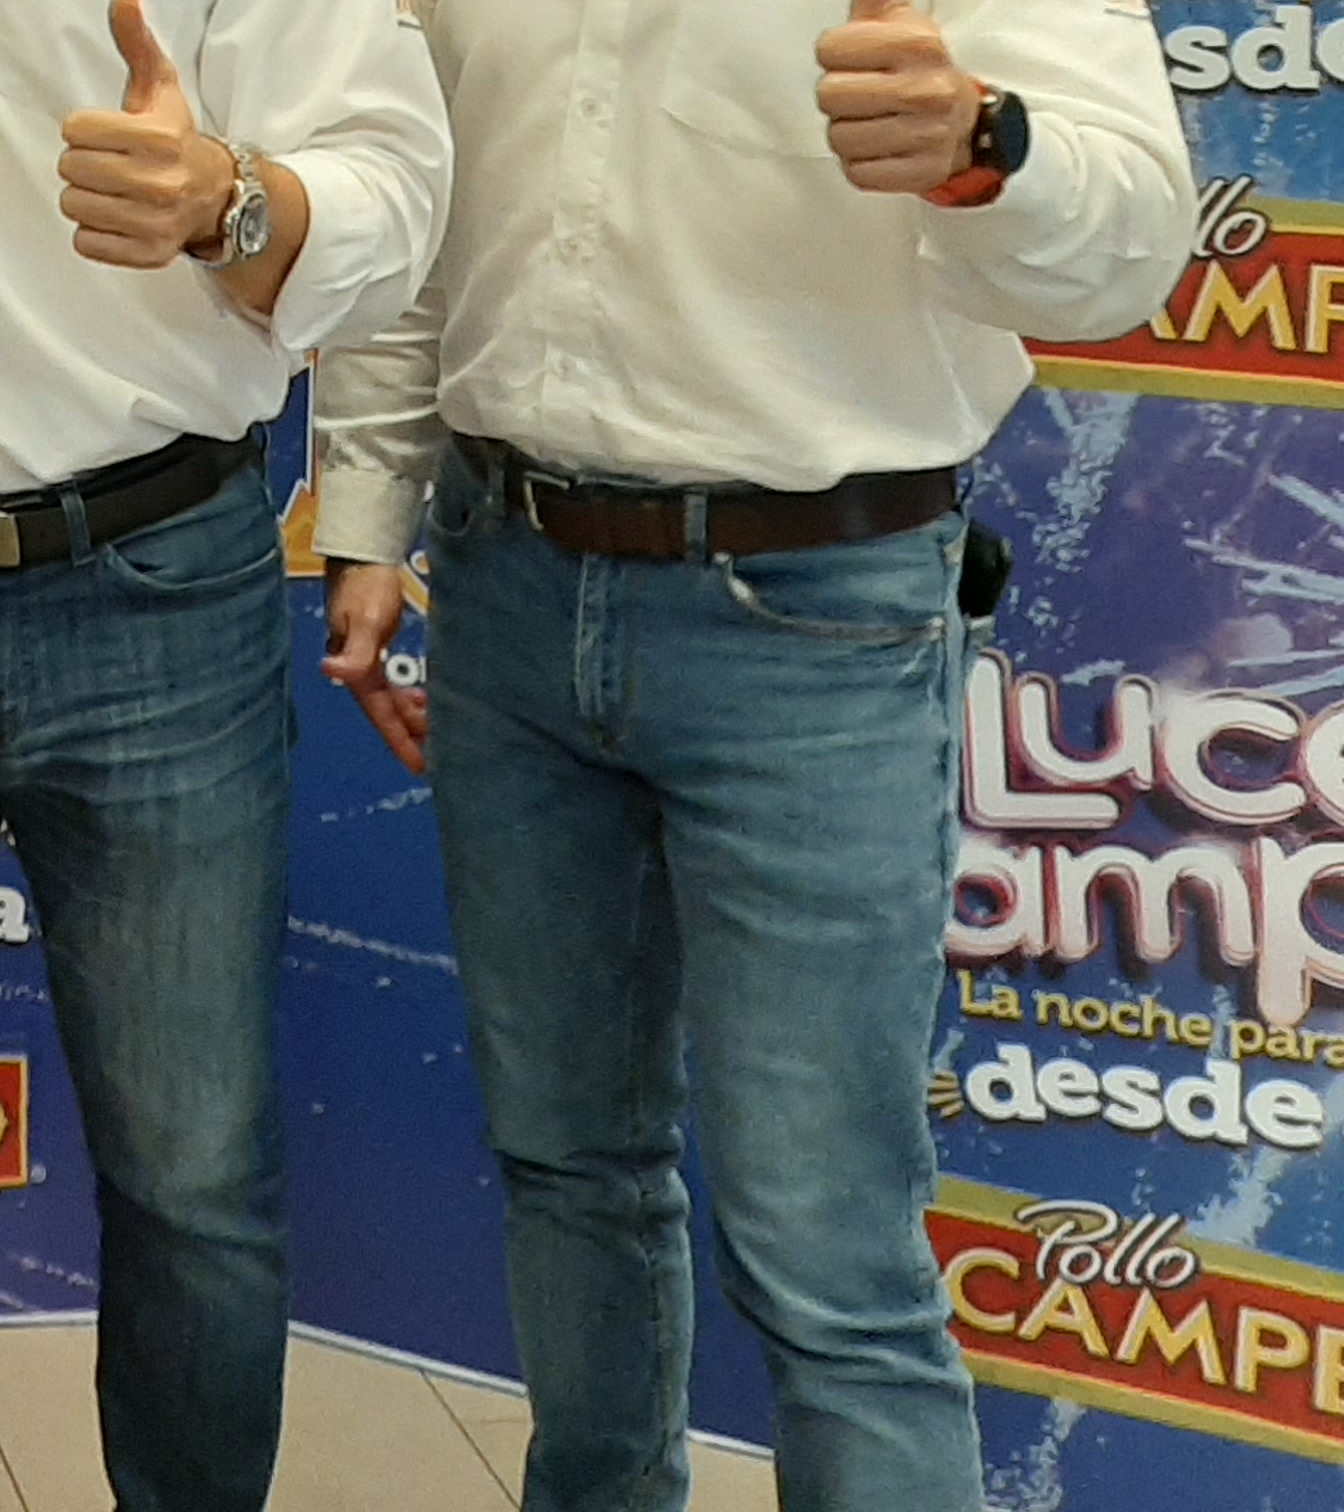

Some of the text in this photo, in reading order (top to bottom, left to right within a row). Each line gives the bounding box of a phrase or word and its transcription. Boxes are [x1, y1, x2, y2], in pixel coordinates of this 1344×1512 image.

[957, 968, 1023, 1020] La
[1034, 990, 1214, 1048] noche
[964, 1042, 1327, 1152] desde
[1015, 1198, 1200, 1289] Pollo
